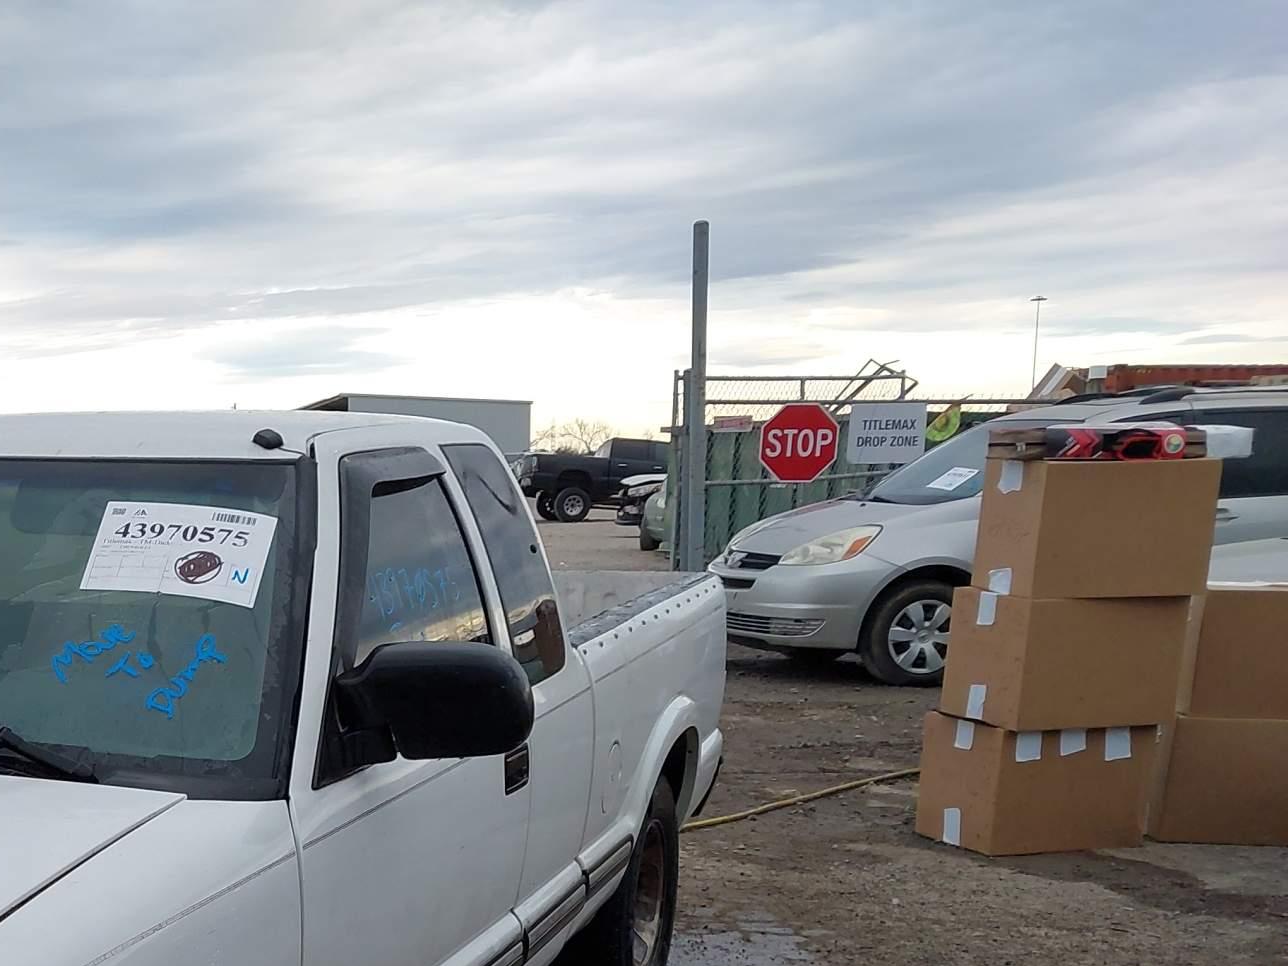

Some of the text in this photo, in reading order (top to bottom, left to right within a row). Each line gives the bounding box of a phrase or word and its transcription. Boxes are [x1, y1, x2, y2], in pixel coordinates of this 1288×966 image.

[862, 419, 917, 430] TITLEMAX
[765, 428, 833, 458] STOP
[857, 435, 919, 447] DROP ZONE
[114, 522, 250, 547] 43970575
[232, 567, 249, 584] N
